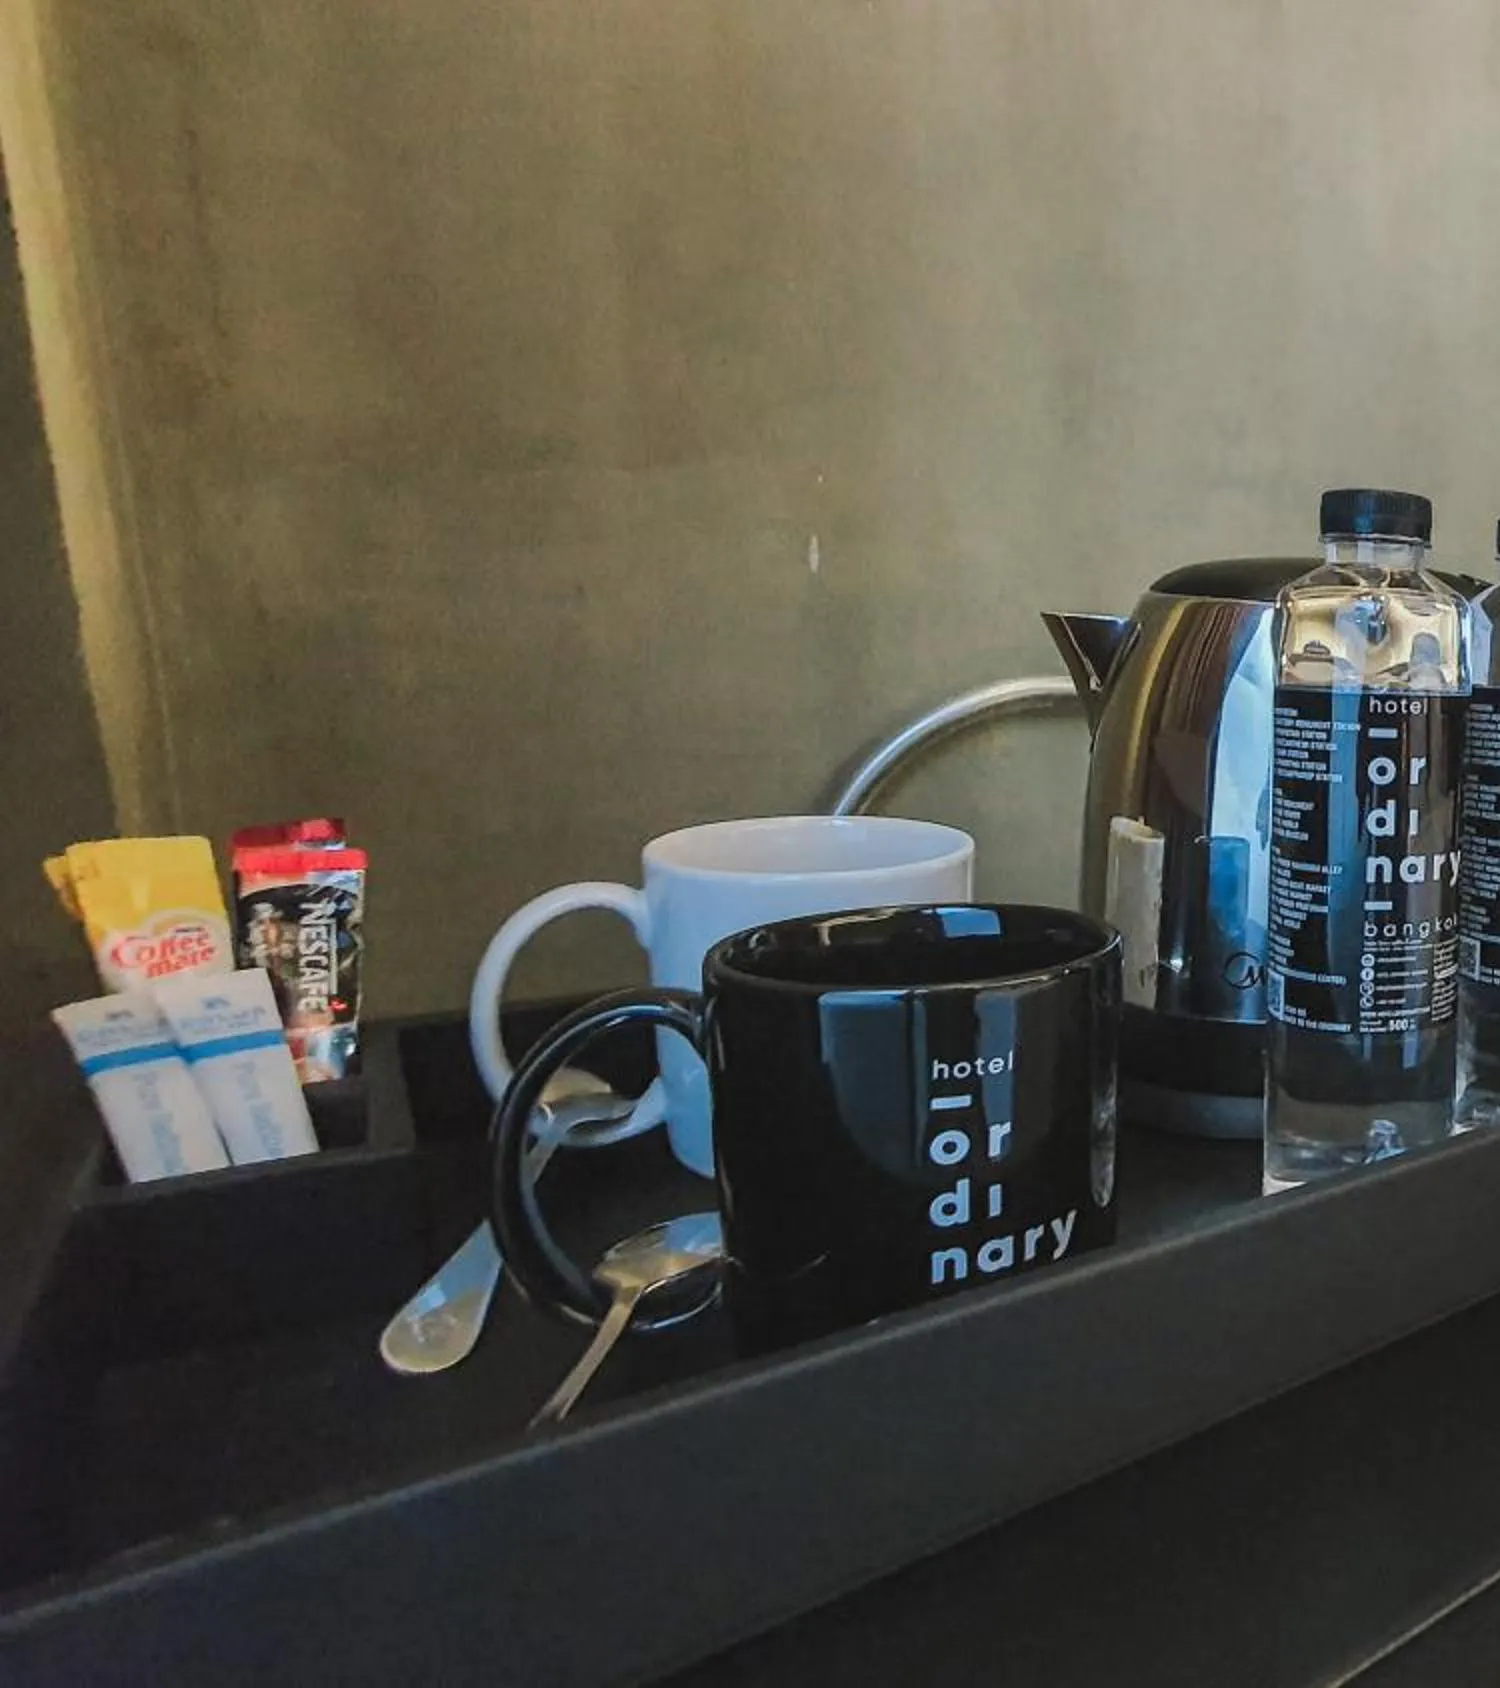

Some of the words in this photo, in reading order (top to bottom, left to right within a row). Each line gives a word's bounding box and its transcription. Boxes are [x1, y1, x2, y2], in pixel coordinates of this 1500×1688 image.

[1369, 696, 1429, 715] hotel
[1367, 755, 1427, 785] or
[1365, 850, 1461, 888] nary
[931, 1049, 1014, 1081] hotel
[929, 1120, 1013, 1166] or
[930, 1208, 1078, 1285] nary
